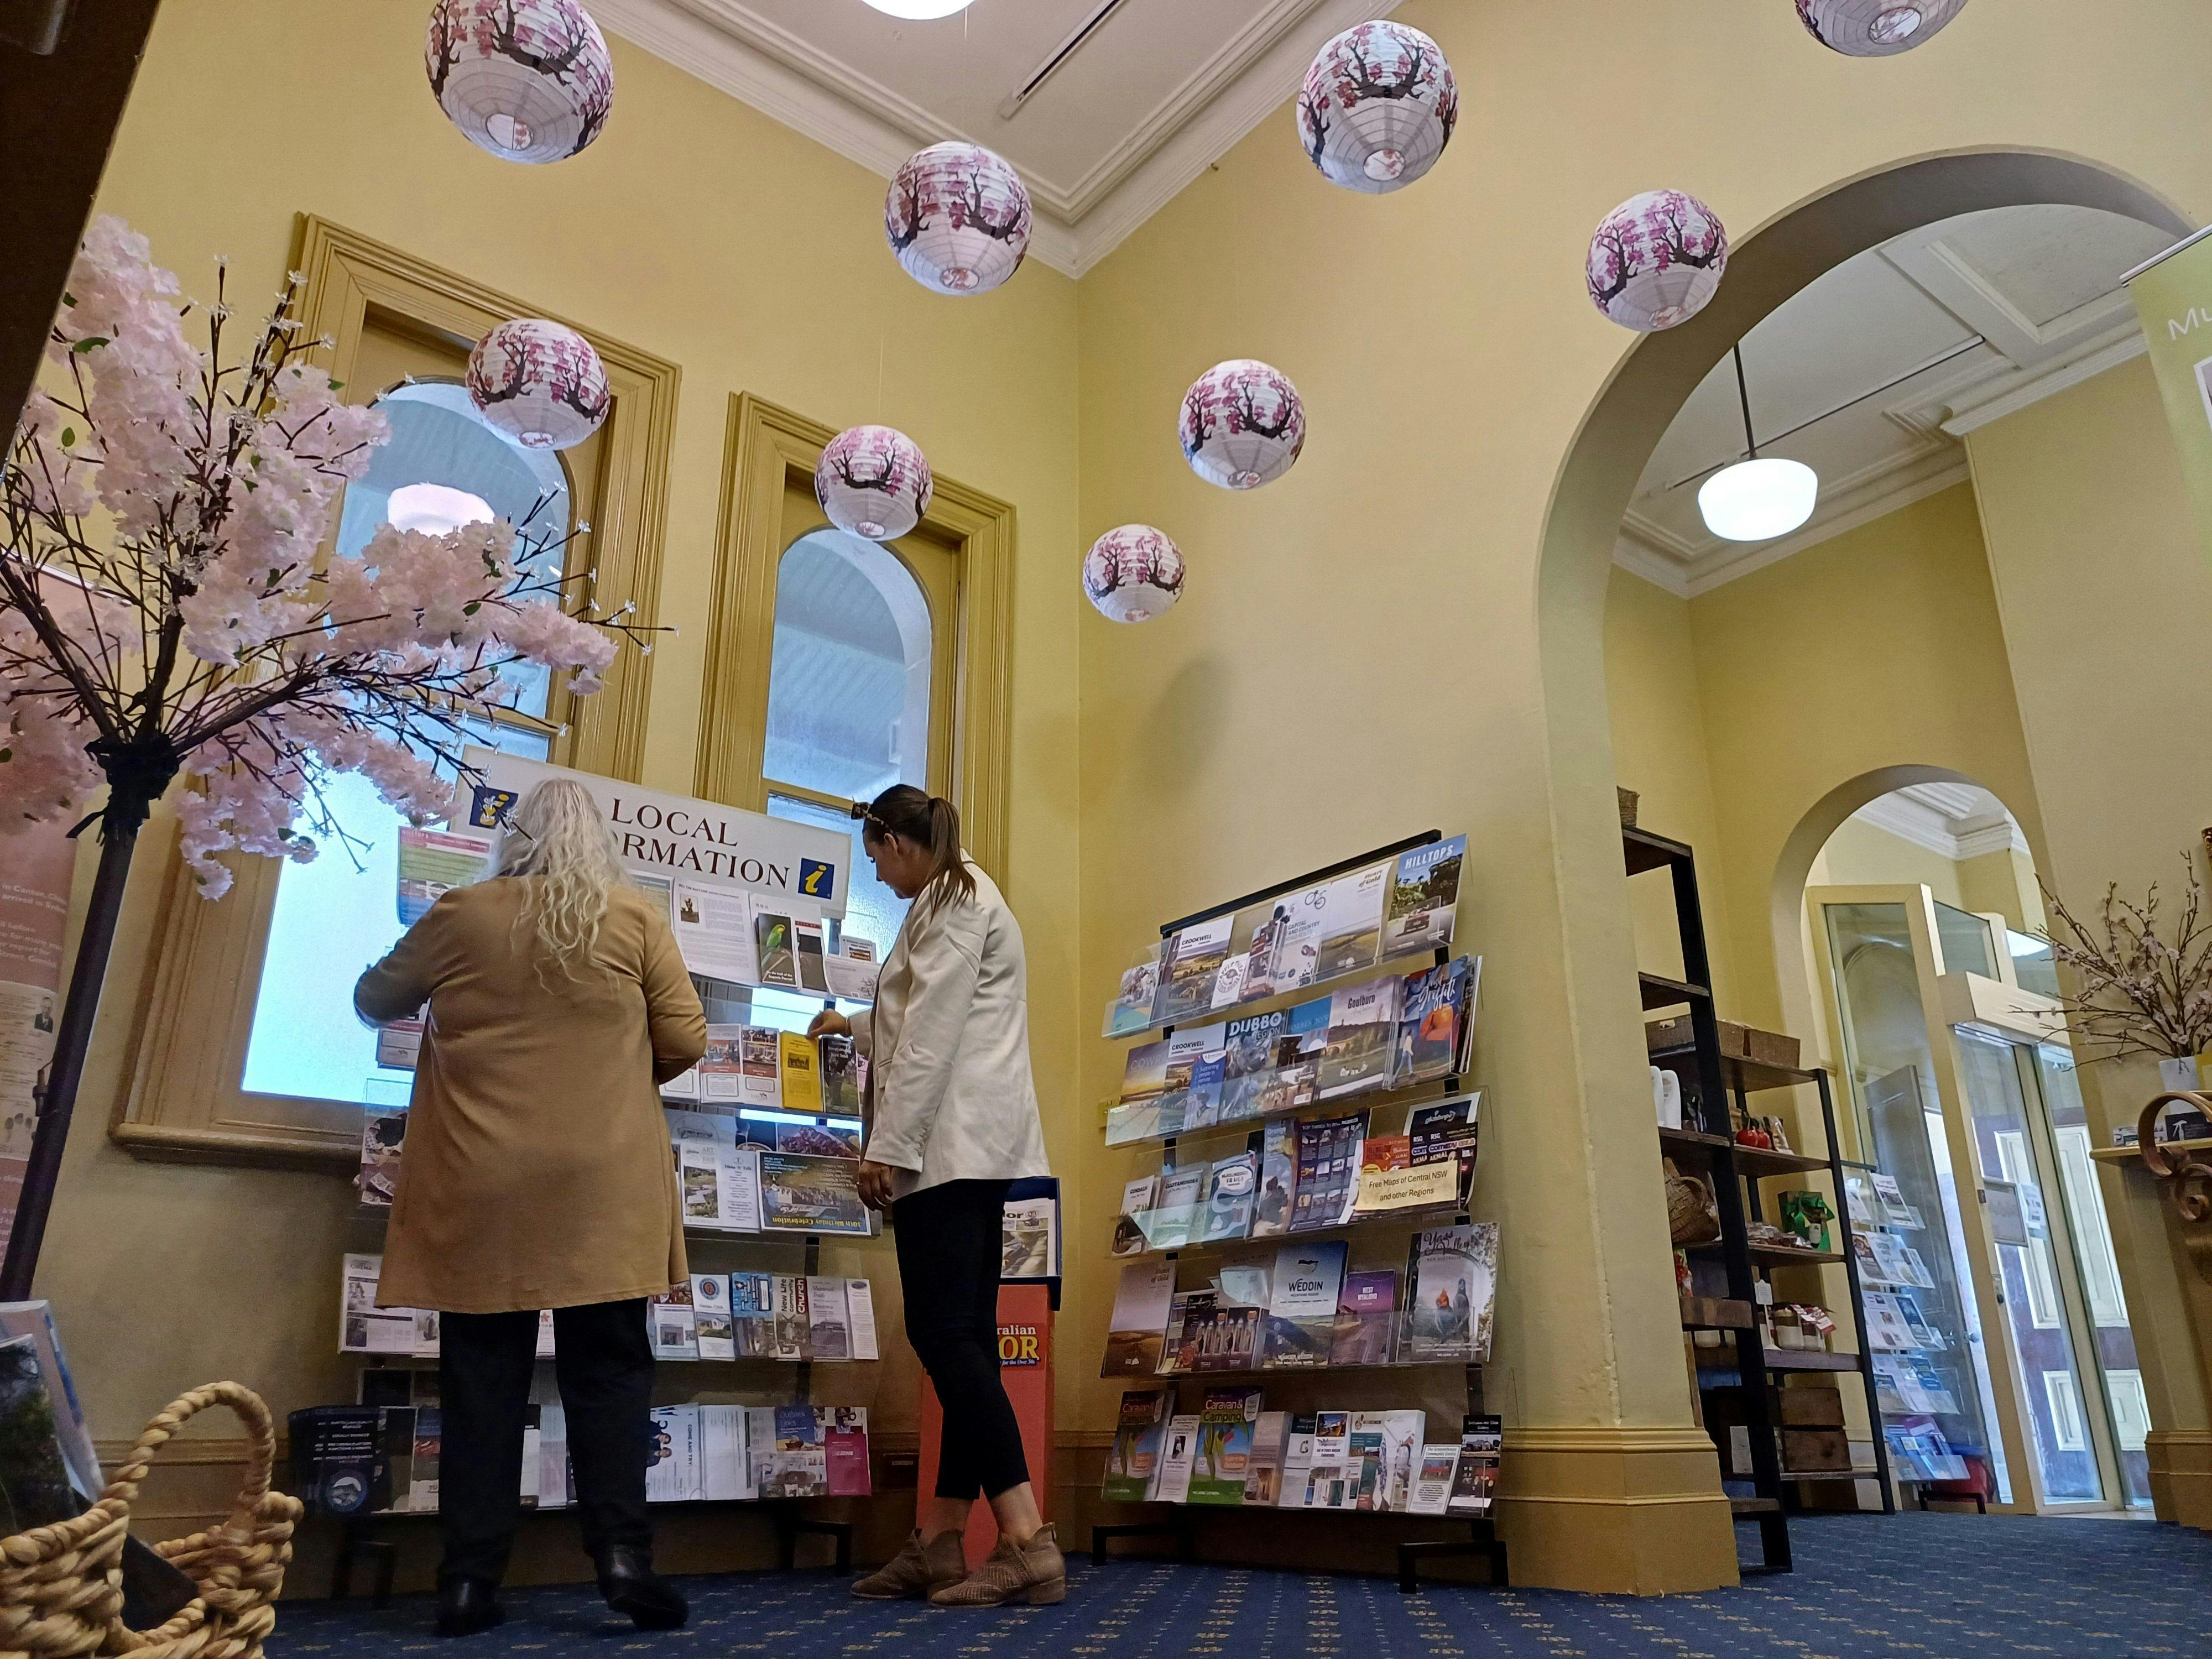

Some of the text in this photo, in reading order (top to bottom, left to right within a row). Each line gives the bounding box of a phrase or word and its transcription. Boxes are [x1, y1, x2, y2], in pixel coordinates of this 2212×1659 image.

[611, 798, 738, 847] LOCAL
[613, 831, 790, 889] RMATION
[1405, 844, 1453, 869] HILLTOPS
[1181, 934, 1212, 946] CROOKWELL
[1348, 994, 1375, 1009] Goulburn
[1229, 1011, 1282, 1036] DUBBO
[1256, 1026, 1281, 1040] EGION
[1172, 1041, 1204, 1051] CROOKWELL
[1369, 1180, 1383, 1189] Free
[1383, 1178, 1400, 1187] Maps
[1407, 1172, 1431, 1182] Central
[1432, 1170, 1448, 1179] NSW
[1380, 1188, 1434, 1201] and other Regions
[772, 1217, 813, 1225] Celebration
[1288, 1278, 1323, 1292] WEDDIN
[796, 1279, 806, 1313] Church
[997, 1324, 1036, 1335] ralian
[1206, 1399, 1237, 1410] Caravan
[1203, 1411, 1241, 1423] Camping
